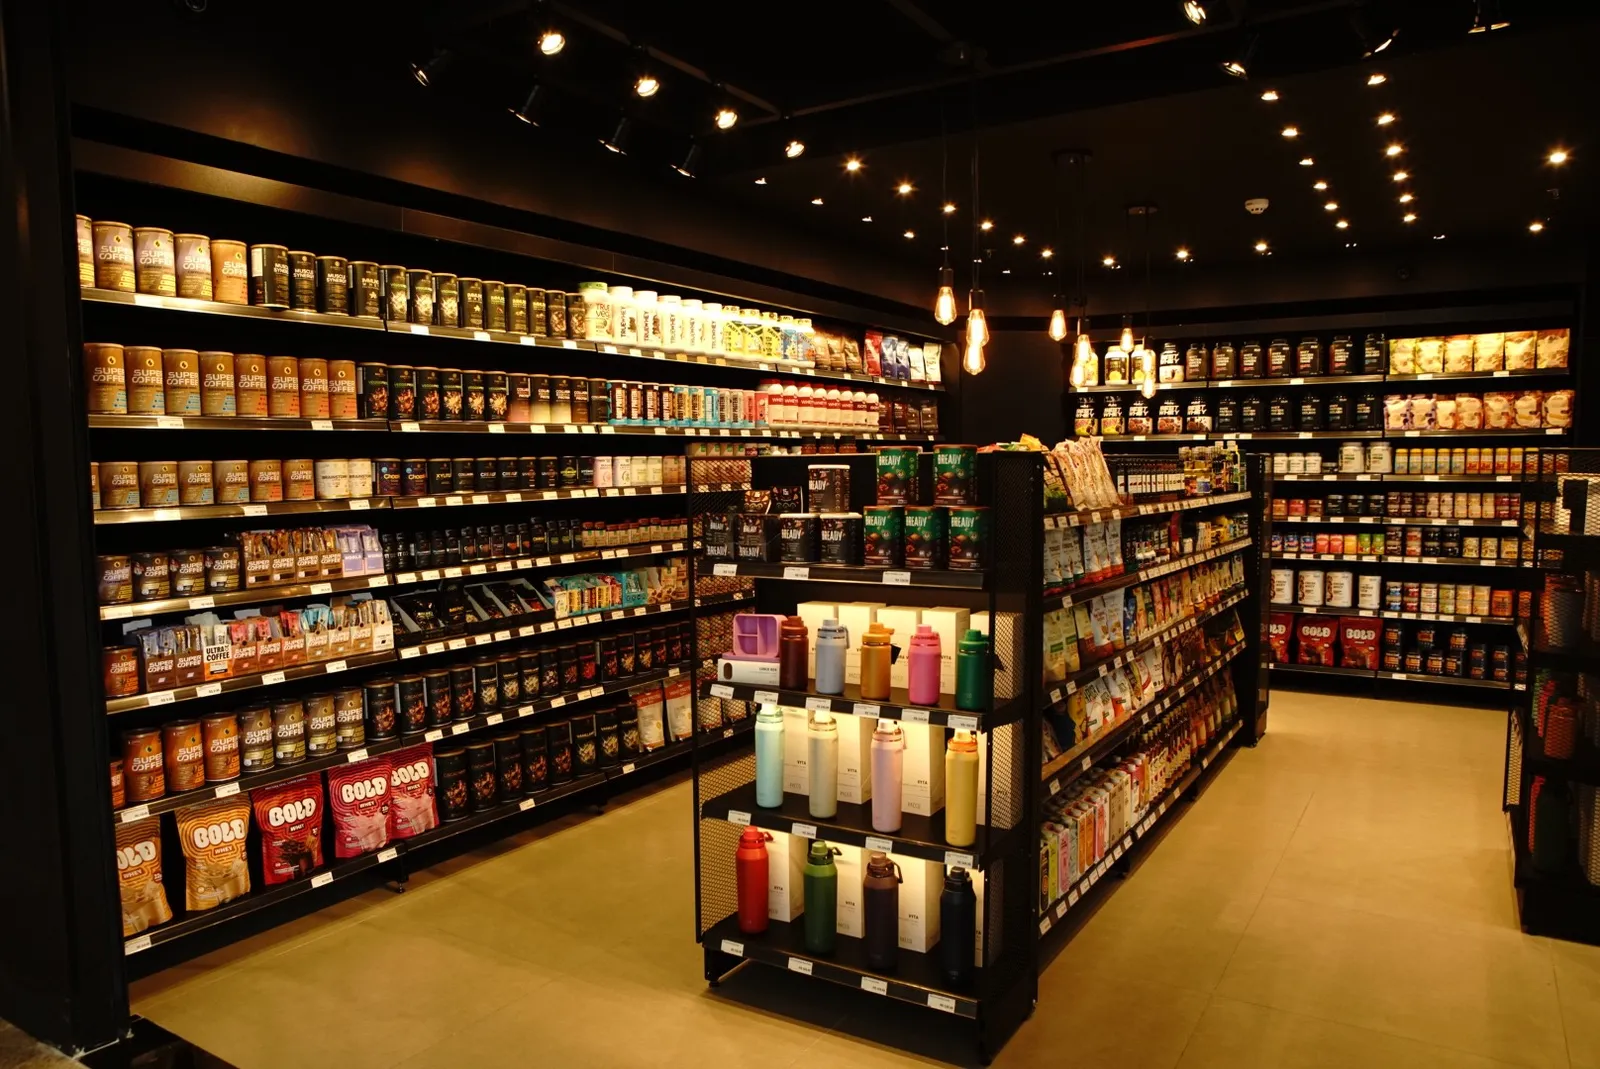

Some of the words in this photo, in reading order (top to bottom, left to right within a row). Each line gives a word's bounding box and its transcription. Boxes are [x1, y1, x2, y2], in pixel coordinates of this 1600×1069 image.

[101, 245, 133, 255] SUPE
[141, 250, 174, 259] SUPE
[222, 267, 248, 276] COFFE
[94, 367, 125, 375] SUPE
[133, 369, 163, 377] SUPE
[878, 455, 901, 466] BREADY
[937, 454, 962, 465] BREADY
[865, 515, 887, 526] BREADY
[905, 516, 928, 527] BREADY
[951, 517, 975, 528] BREADY
[781, 529, 802, 540] BREADY
[821, 530, 843, 541] BREADY
[1302, 626, 1331, 637] BOLD
[1345, 628, 1376, 640] BOLD
[206, 647, 224, 655] ULTRA
[234, 645, 256, 653] SUPER
[178, 655, 202, 663] SUPER
[206, 651, 231, 661] COFFEE
[111, 659, 136, 668] SUPER
[149, 659, 173, 668] SUPER
[176, 660, 201, 668] COFFEE
[147, 665, 173, 673] COFFEE
[391, 761, 429, 787] BOLD
[341, 777, 387, 803] BOLD
[268, 797, 317, 827] BOLD
[290, 823, 305, 832] WHEY
[193, 818, 246, 849] BOLD
[116, 840, 157, 870] OLD
[214, 845, 233, 855] WHEY
[123, 869, 142, 879] WHEY
